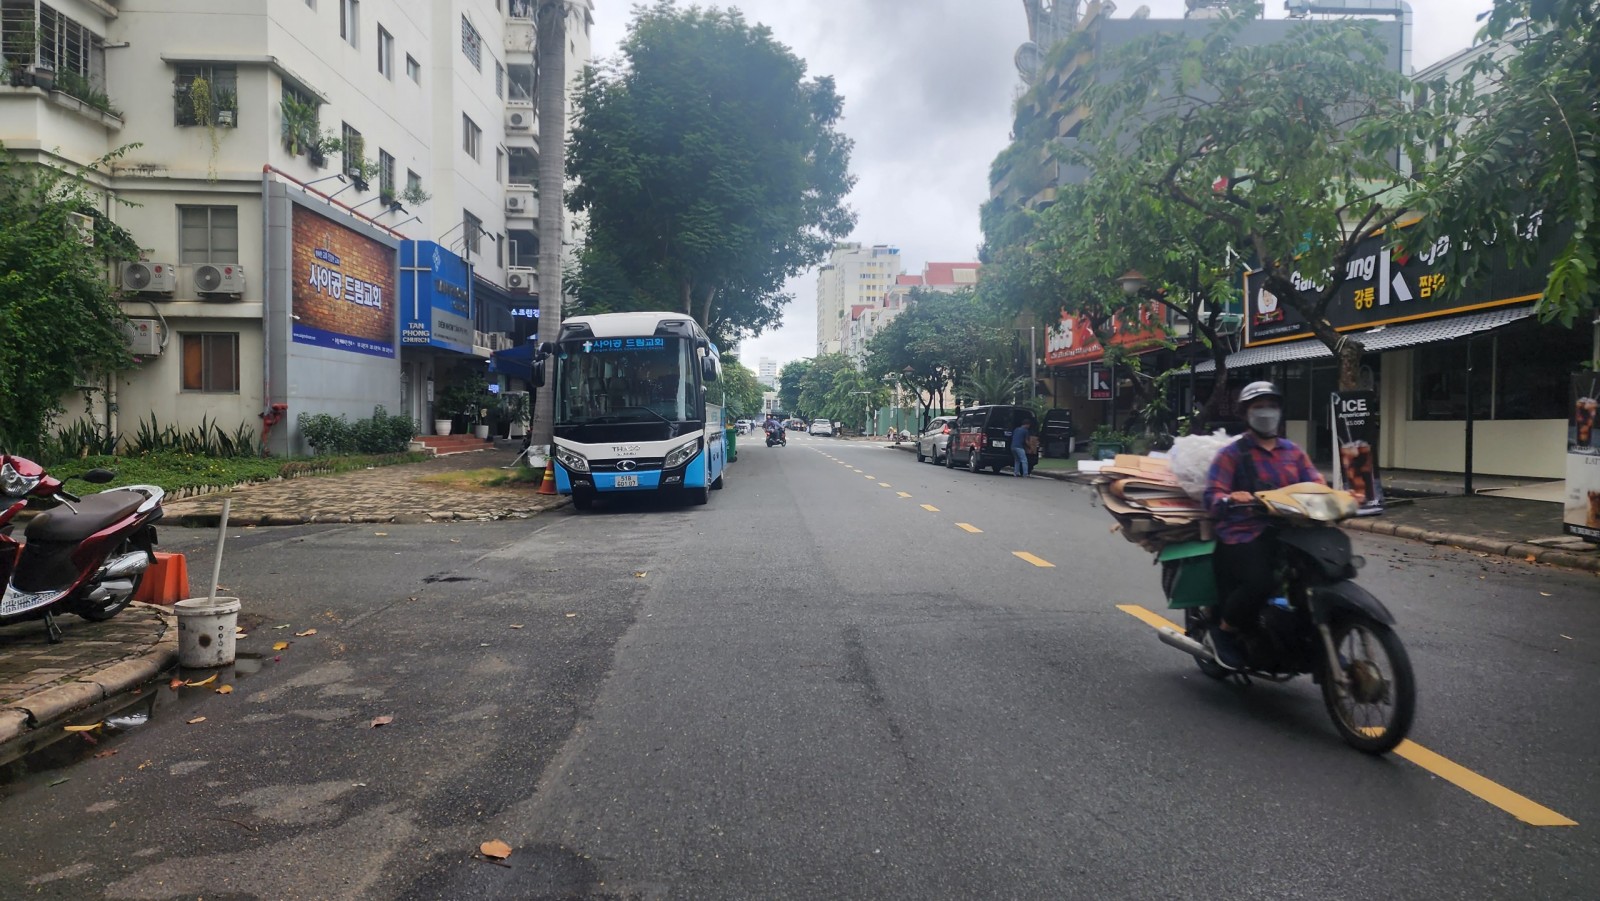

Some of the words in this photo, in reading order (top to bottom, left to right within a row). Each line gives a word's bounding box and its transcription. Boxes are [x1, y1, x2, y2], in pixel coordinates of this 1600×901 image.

[309, 264, 342, 299] 사이공
[344, 275, 382, 309] 드림교회
[1354, 287, 1375, 310] 강릉
[402, 336, 430, 344] CHURCH
[593, 339, 622, 348] 사이공
[626, 338, 664, 347] 드림교회
[1342, 399, 1367, 412] ICE
